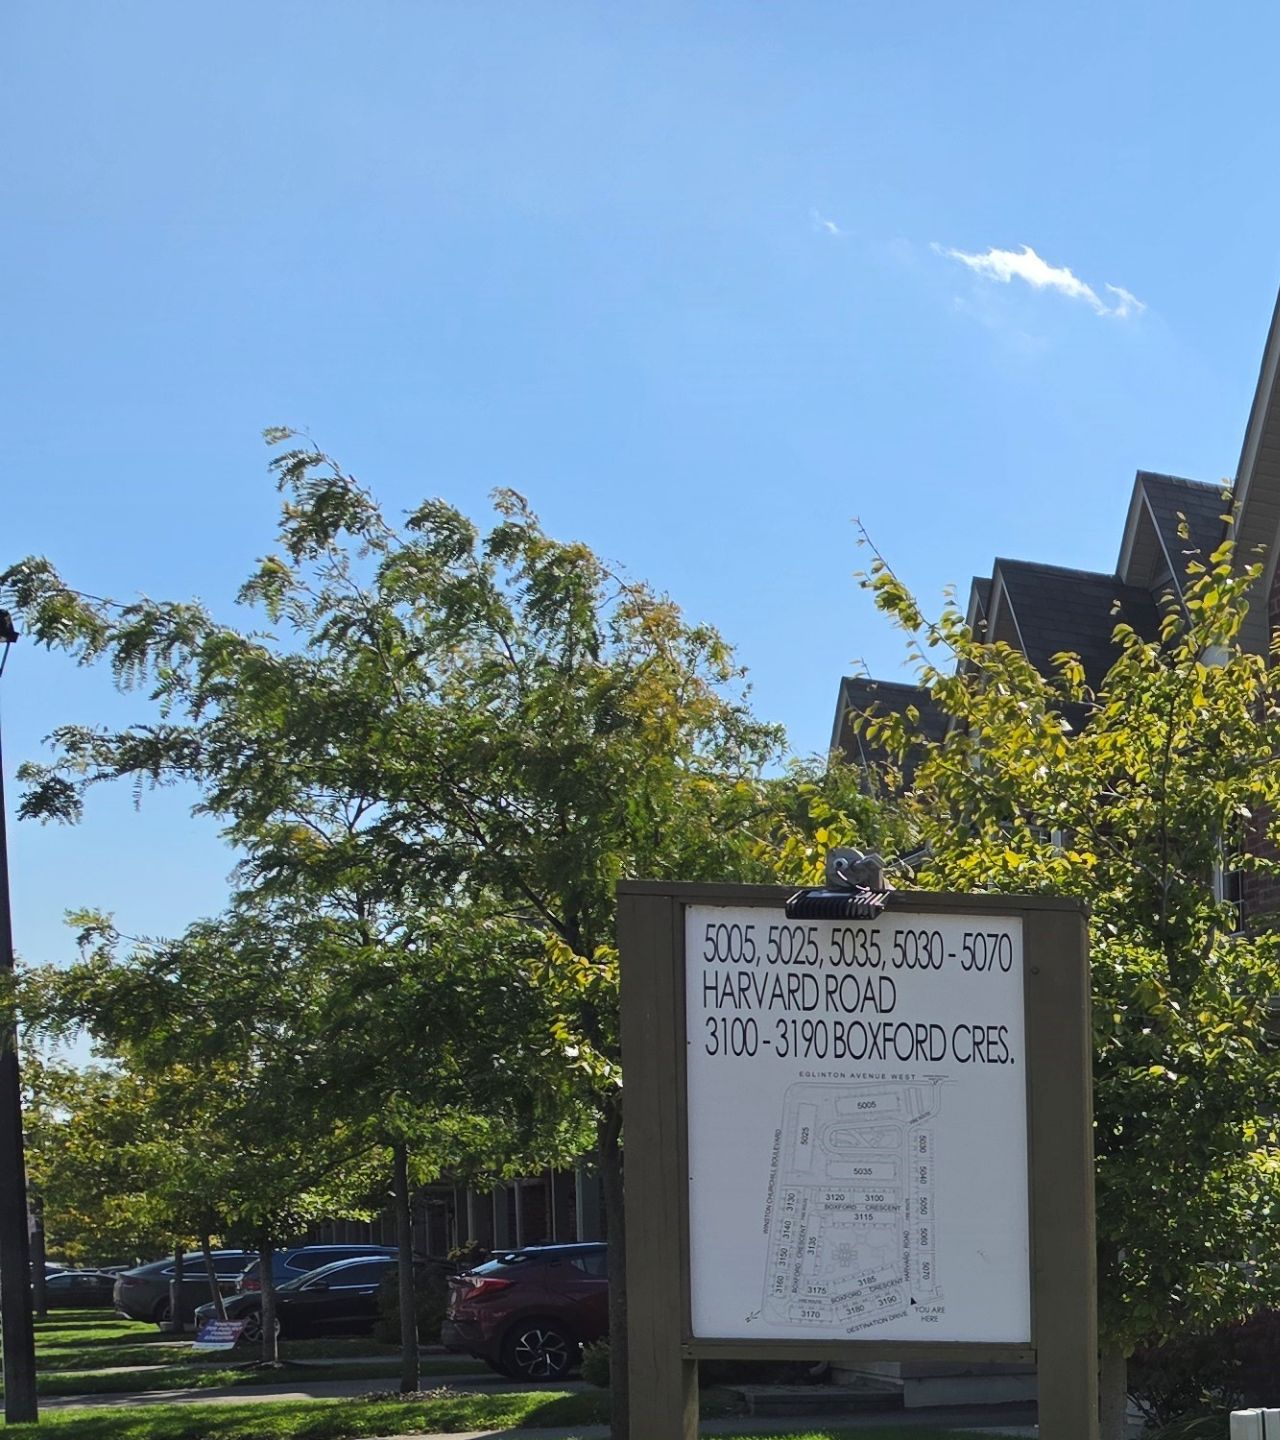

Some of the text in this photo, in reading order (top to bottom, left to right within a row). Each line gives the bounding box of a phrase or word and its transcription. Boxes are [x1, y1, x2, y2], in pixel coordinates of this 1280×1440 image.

[704, 923, 760, 967] 5005,
[766, 925, 823, 969] 5025,
[829, 927, 886, 971] 5035,
[892, 929, 944, 970] 5030
[961, 932, 1013, 972] 5070
[703, 970, 897, 1014] HARVARD ROAD
[705, 1016, 758, 1056] 3100
[775, 1018, 828, 1059] 3190
[834, 1020, 946, 1062] BOXFORD
[952, 1023, 1015, 1064] CRES.
[857, 1101, 877, 1109] 5005
[800, 1127, 810, 1145] 5025
[853, 1167, 873, 1175] 5035
[825, 1193, 845, 1201] 3120
[864, 1194, 884, 1202] 3100
[854, 1213, 874, 1221] 3115
[783, 1220, 792, 1239] 3140
[807, 1236, 817, 1255] 3135
[779, 1247, 788, 1267] 3150
[807, 1286, 827, 1295] 3175
[801, 1310, 821, 1318] 3170
[914, 1306, 945, 1314] YOU ARE
[920, 1315, 939, 1323] HERE
